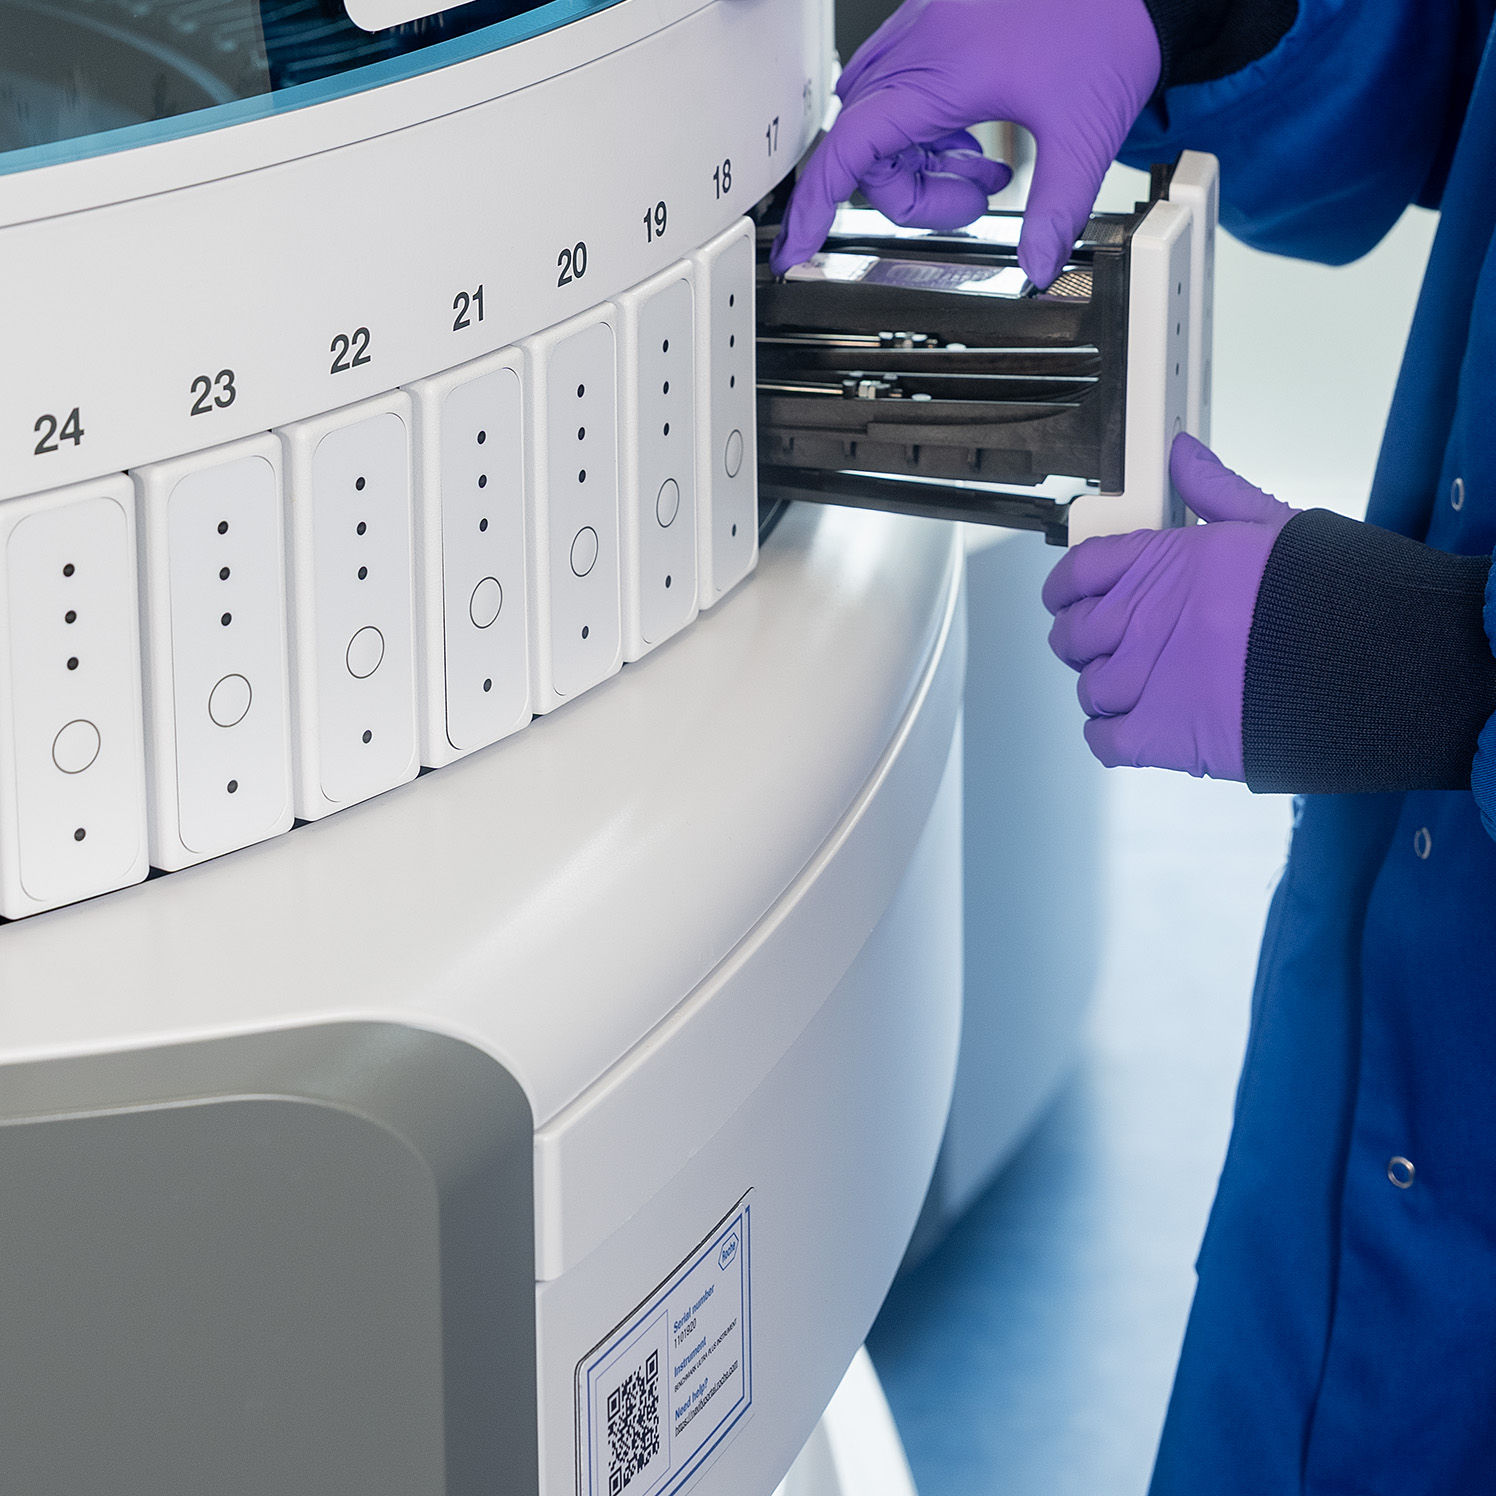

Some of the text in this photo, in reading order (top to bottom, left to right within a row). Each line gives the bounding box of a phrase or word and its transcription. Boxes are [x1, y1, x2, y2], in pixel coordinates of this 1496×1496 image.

[34, 407, 85, 456] 24
[190, 369, 236, 417] 23
[330, 326, 371, 375] 22
[452, 284, 484, 332] 21
[557, 241, 588, 288] 20
[643, 200, 667, 244] 19
[712, 158, 732, 200] 18
[765, 115, 779, 157] 17
[721, 1241, 736, 1263] Roche
[673, 1284, 715, 1334] Serial number
[674, 1317, 697, 1349] 1101920
[674, 1335, 707, 1379] Instrument
[675, 1377, 709, 1421] Need help?
